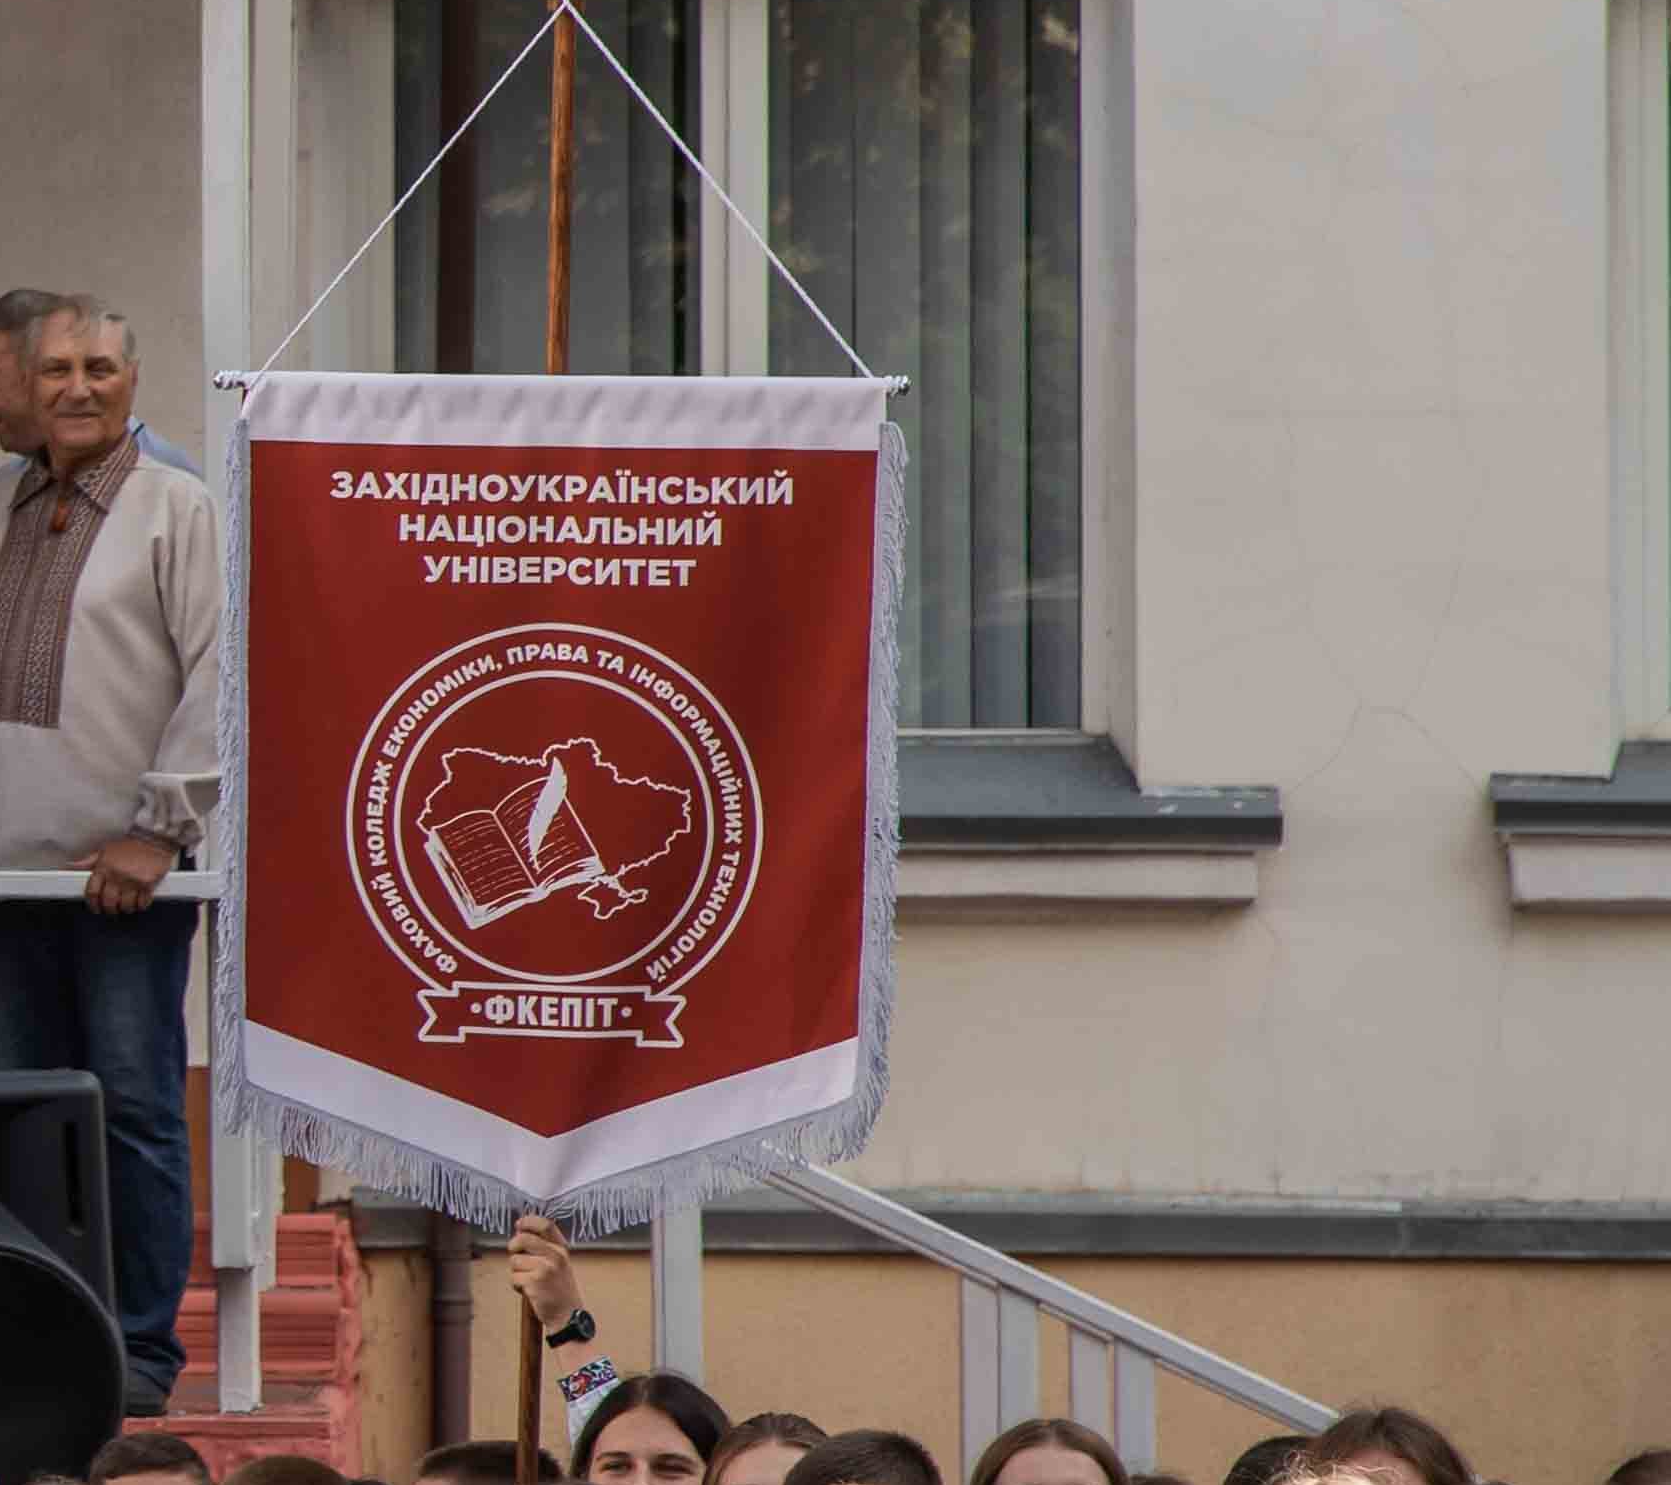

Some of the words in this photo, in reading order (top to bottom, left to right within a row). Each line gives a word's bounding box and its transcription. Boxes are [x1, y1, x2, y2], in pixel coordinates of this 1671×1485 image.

[330, 469, 794, 505] ЗАХІДНОУКРАЇНСЬКИЙ
[398, 510, 723, 547] НАЦІОНАЛЬНИЙ
[423, 555, 697, 587] УНІВЕРСИТЕТ
[506, 642, 589, 665] ПРАВА
[596, 649, 625, 675] ТА
[381, 654, 503, 759] ЕКОНОМІКИ,
[629, 662, 744, 845] ІНФОРМАЦІЙНИХ
[366, 760, 394, 868] КОЛЕДЖ
[369, 872, 459, 975] ФАХОВИЙ
[645, 848, 743, 984] ТЕХНОЛОГІЙ
[485, 994, 619, 1028] ФКЕПІТ
